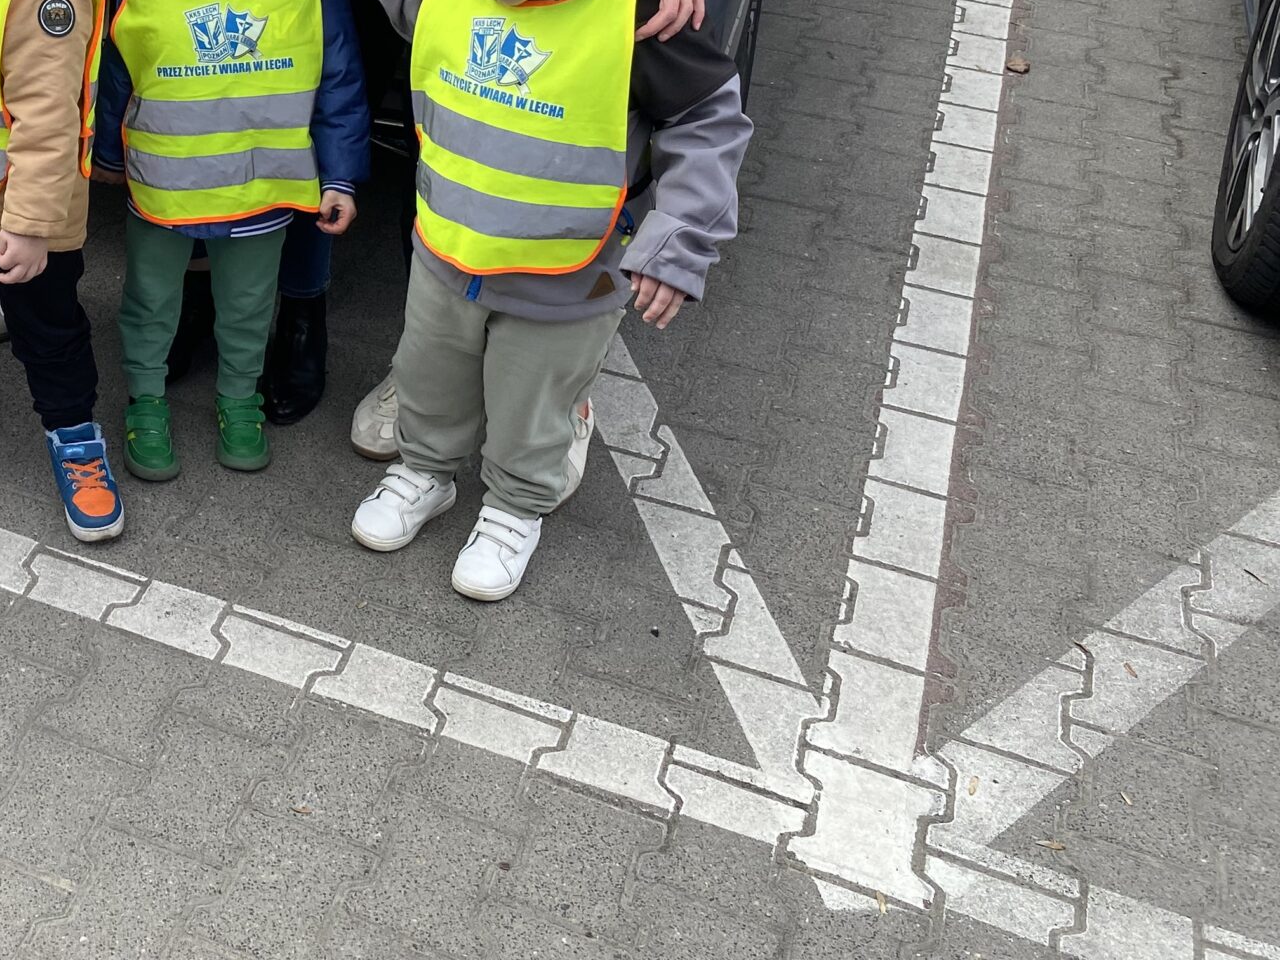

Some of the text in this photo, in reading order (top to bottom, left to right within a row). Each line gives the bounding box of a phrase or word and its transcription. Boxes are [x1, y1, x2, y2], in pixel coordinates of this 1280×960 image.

[46, 2, 68, 10] CAMP
[189, 5, 218, 19] KKS LECH
[475, 19, 485, 27] KKS
[157, 58, 294, 77] PRZEZ ŻYCIE Z WIARĄ W LECHA
[472, 83, 479, 96] Z
[515, 95, 528, 110] W
[529, 100, 564, 118] LECHA
